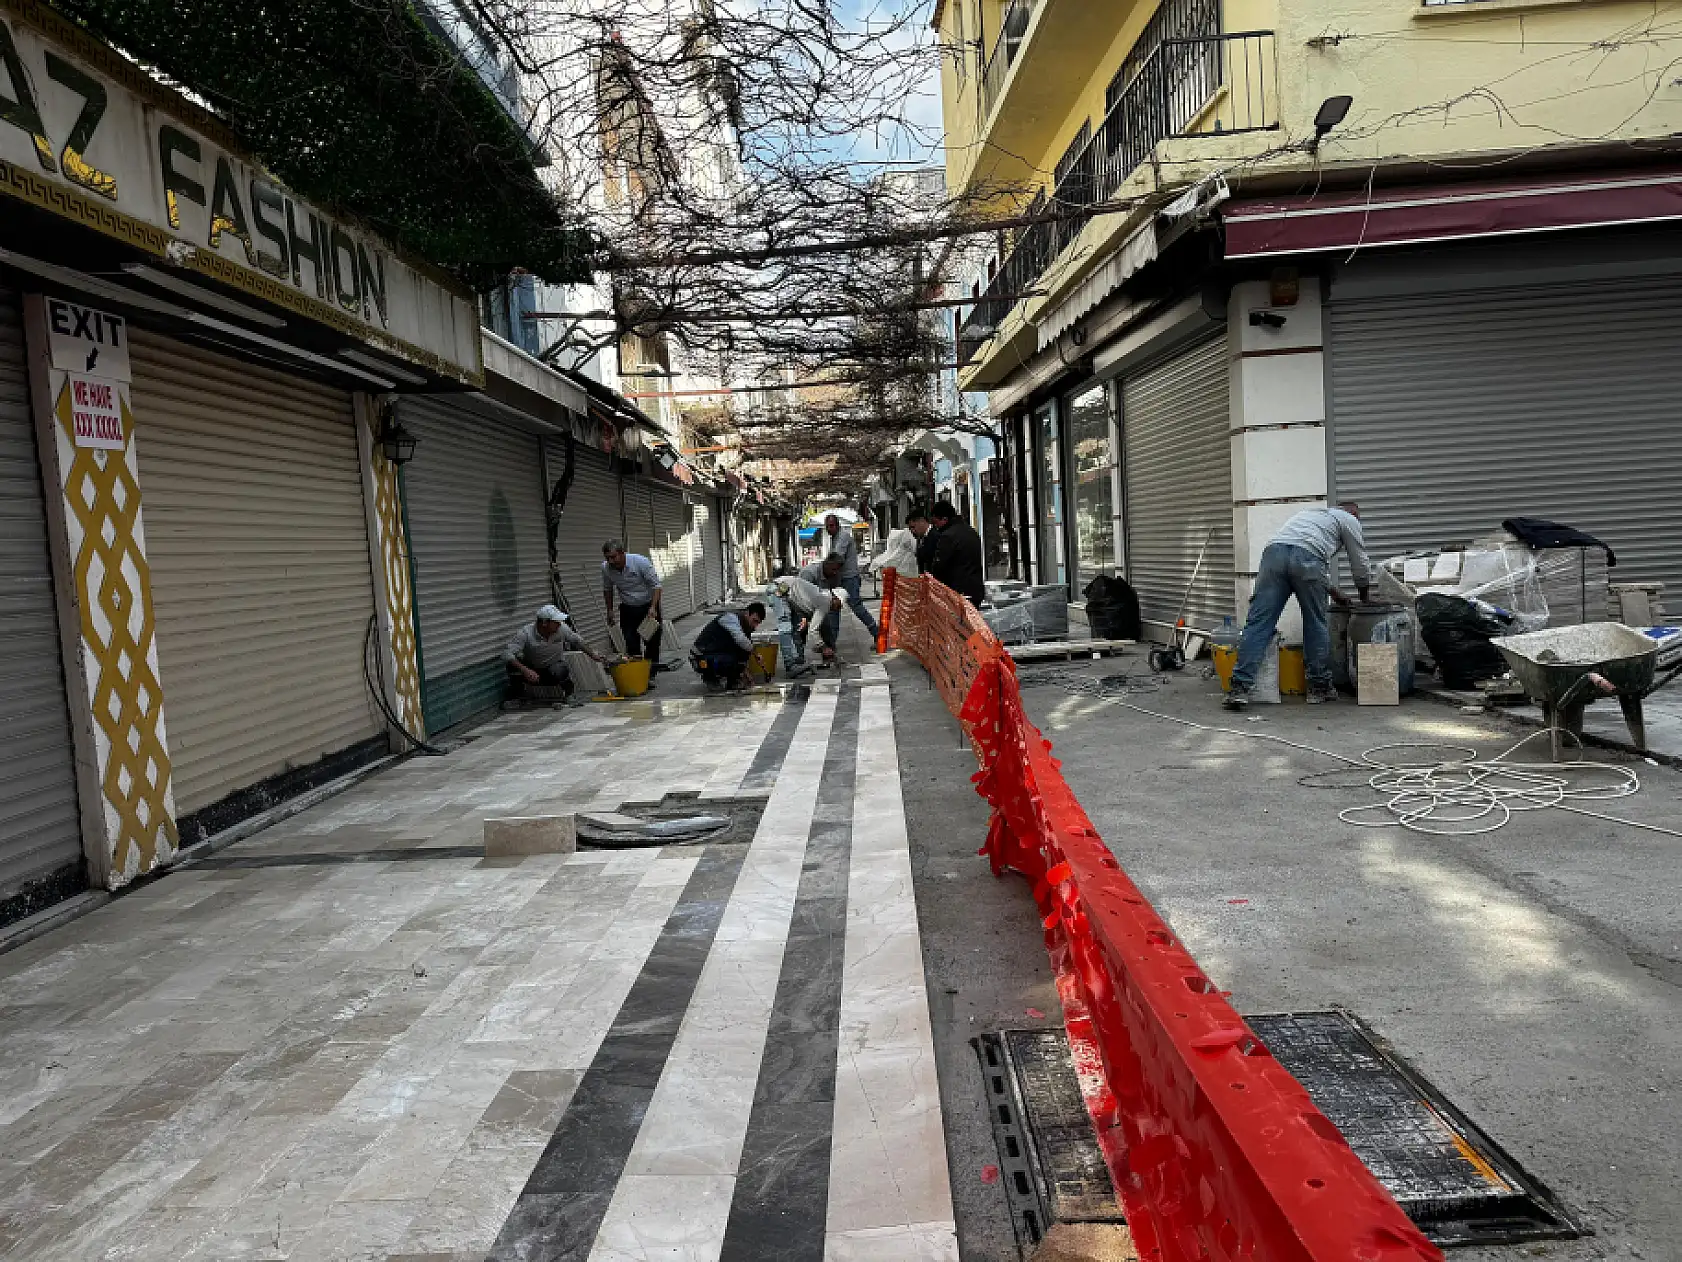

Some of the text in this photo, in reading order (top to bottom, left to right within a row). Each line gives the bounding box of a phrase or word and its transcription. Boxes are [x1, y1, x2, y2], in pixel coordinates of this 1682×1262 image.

[160, 124, 387, 330] FASHION
[51, 301, 122, 347] EXIT
[73, 380, 113, 411] WE HAVE
